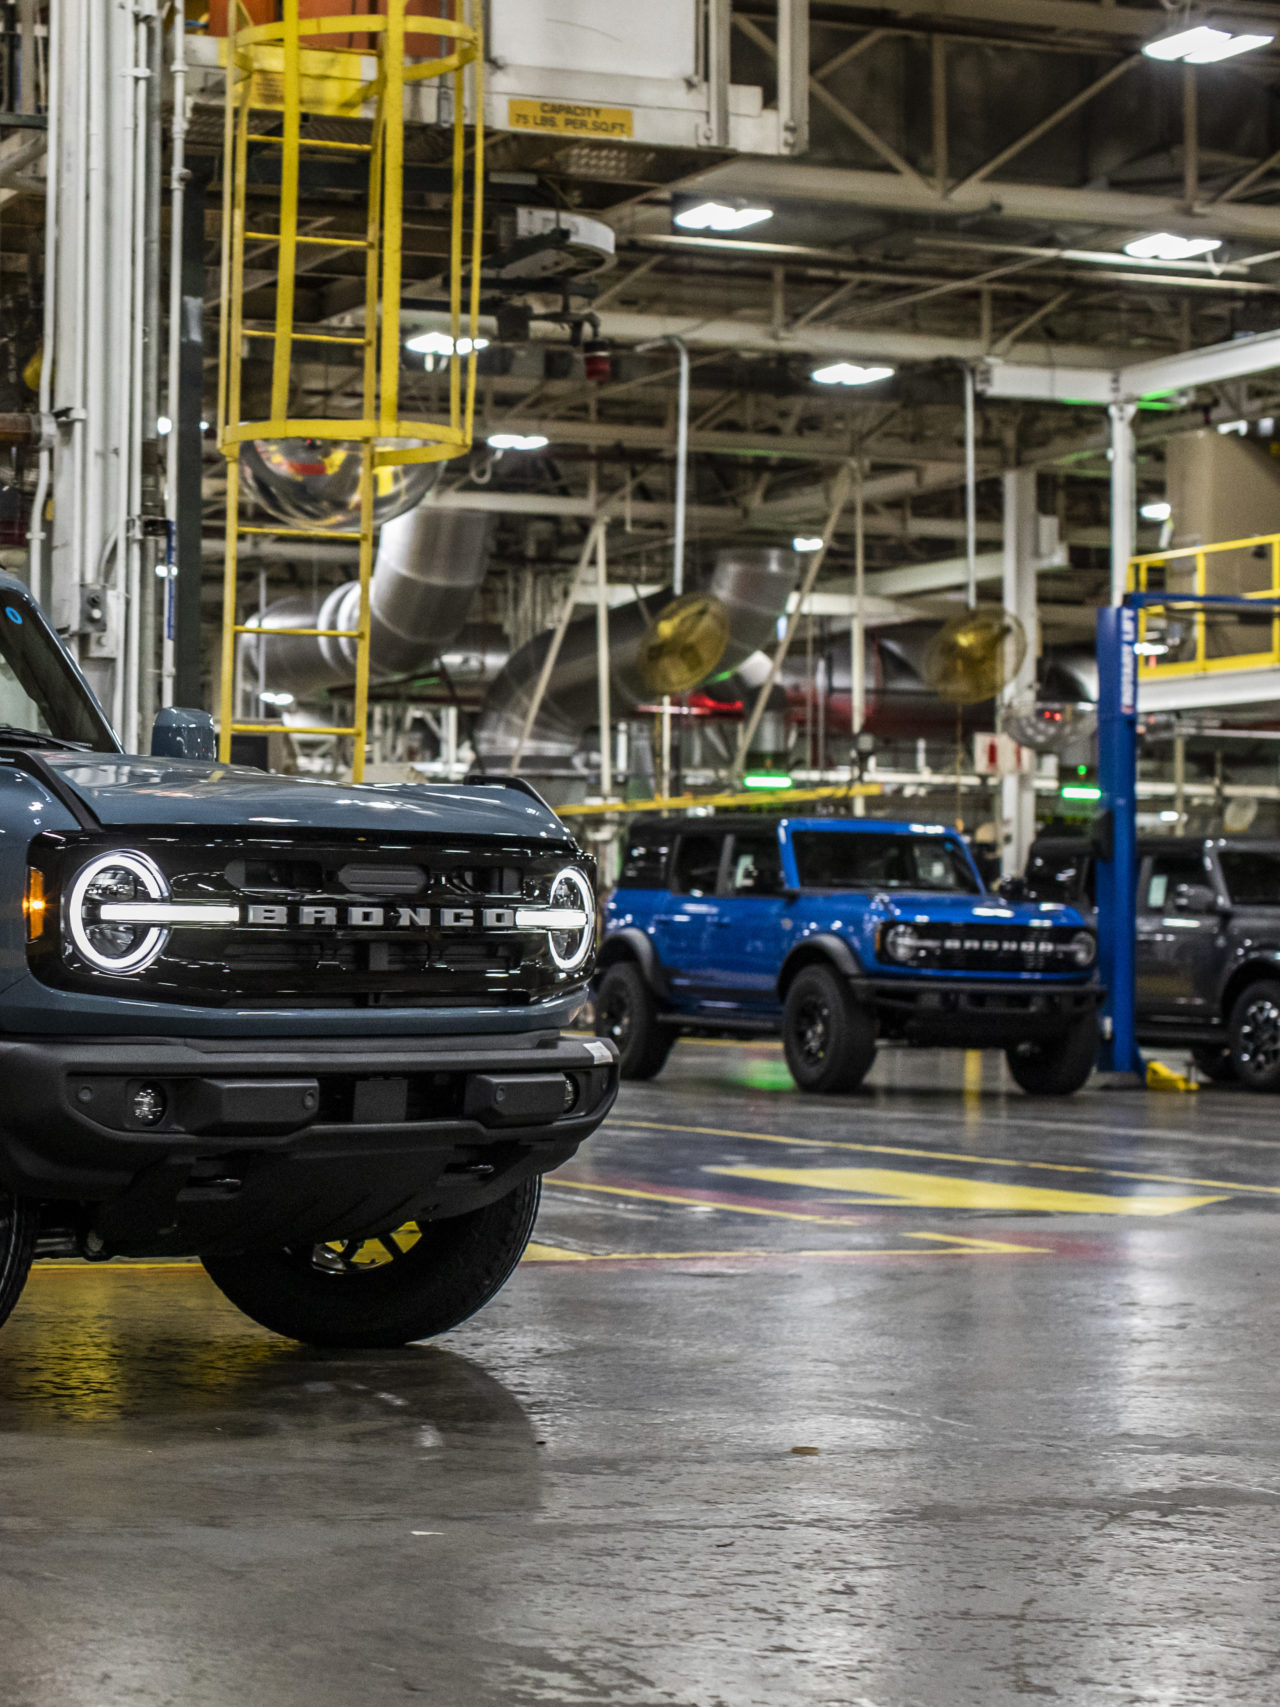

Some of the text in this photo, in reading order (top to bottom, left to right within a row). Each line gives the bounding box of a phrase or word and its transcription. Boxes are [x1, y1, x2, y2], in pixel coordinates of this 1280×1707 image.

[539, 102, 602, 118] CAPACITY
[515, 113, 529, 125] 75
[533, 114, 558, 128] LBS.
[1122, 609, 1135, 641] LIFT
[247, 905, 515, 927] BRONCO
[943, 939, 1055, 952] BRONCO
